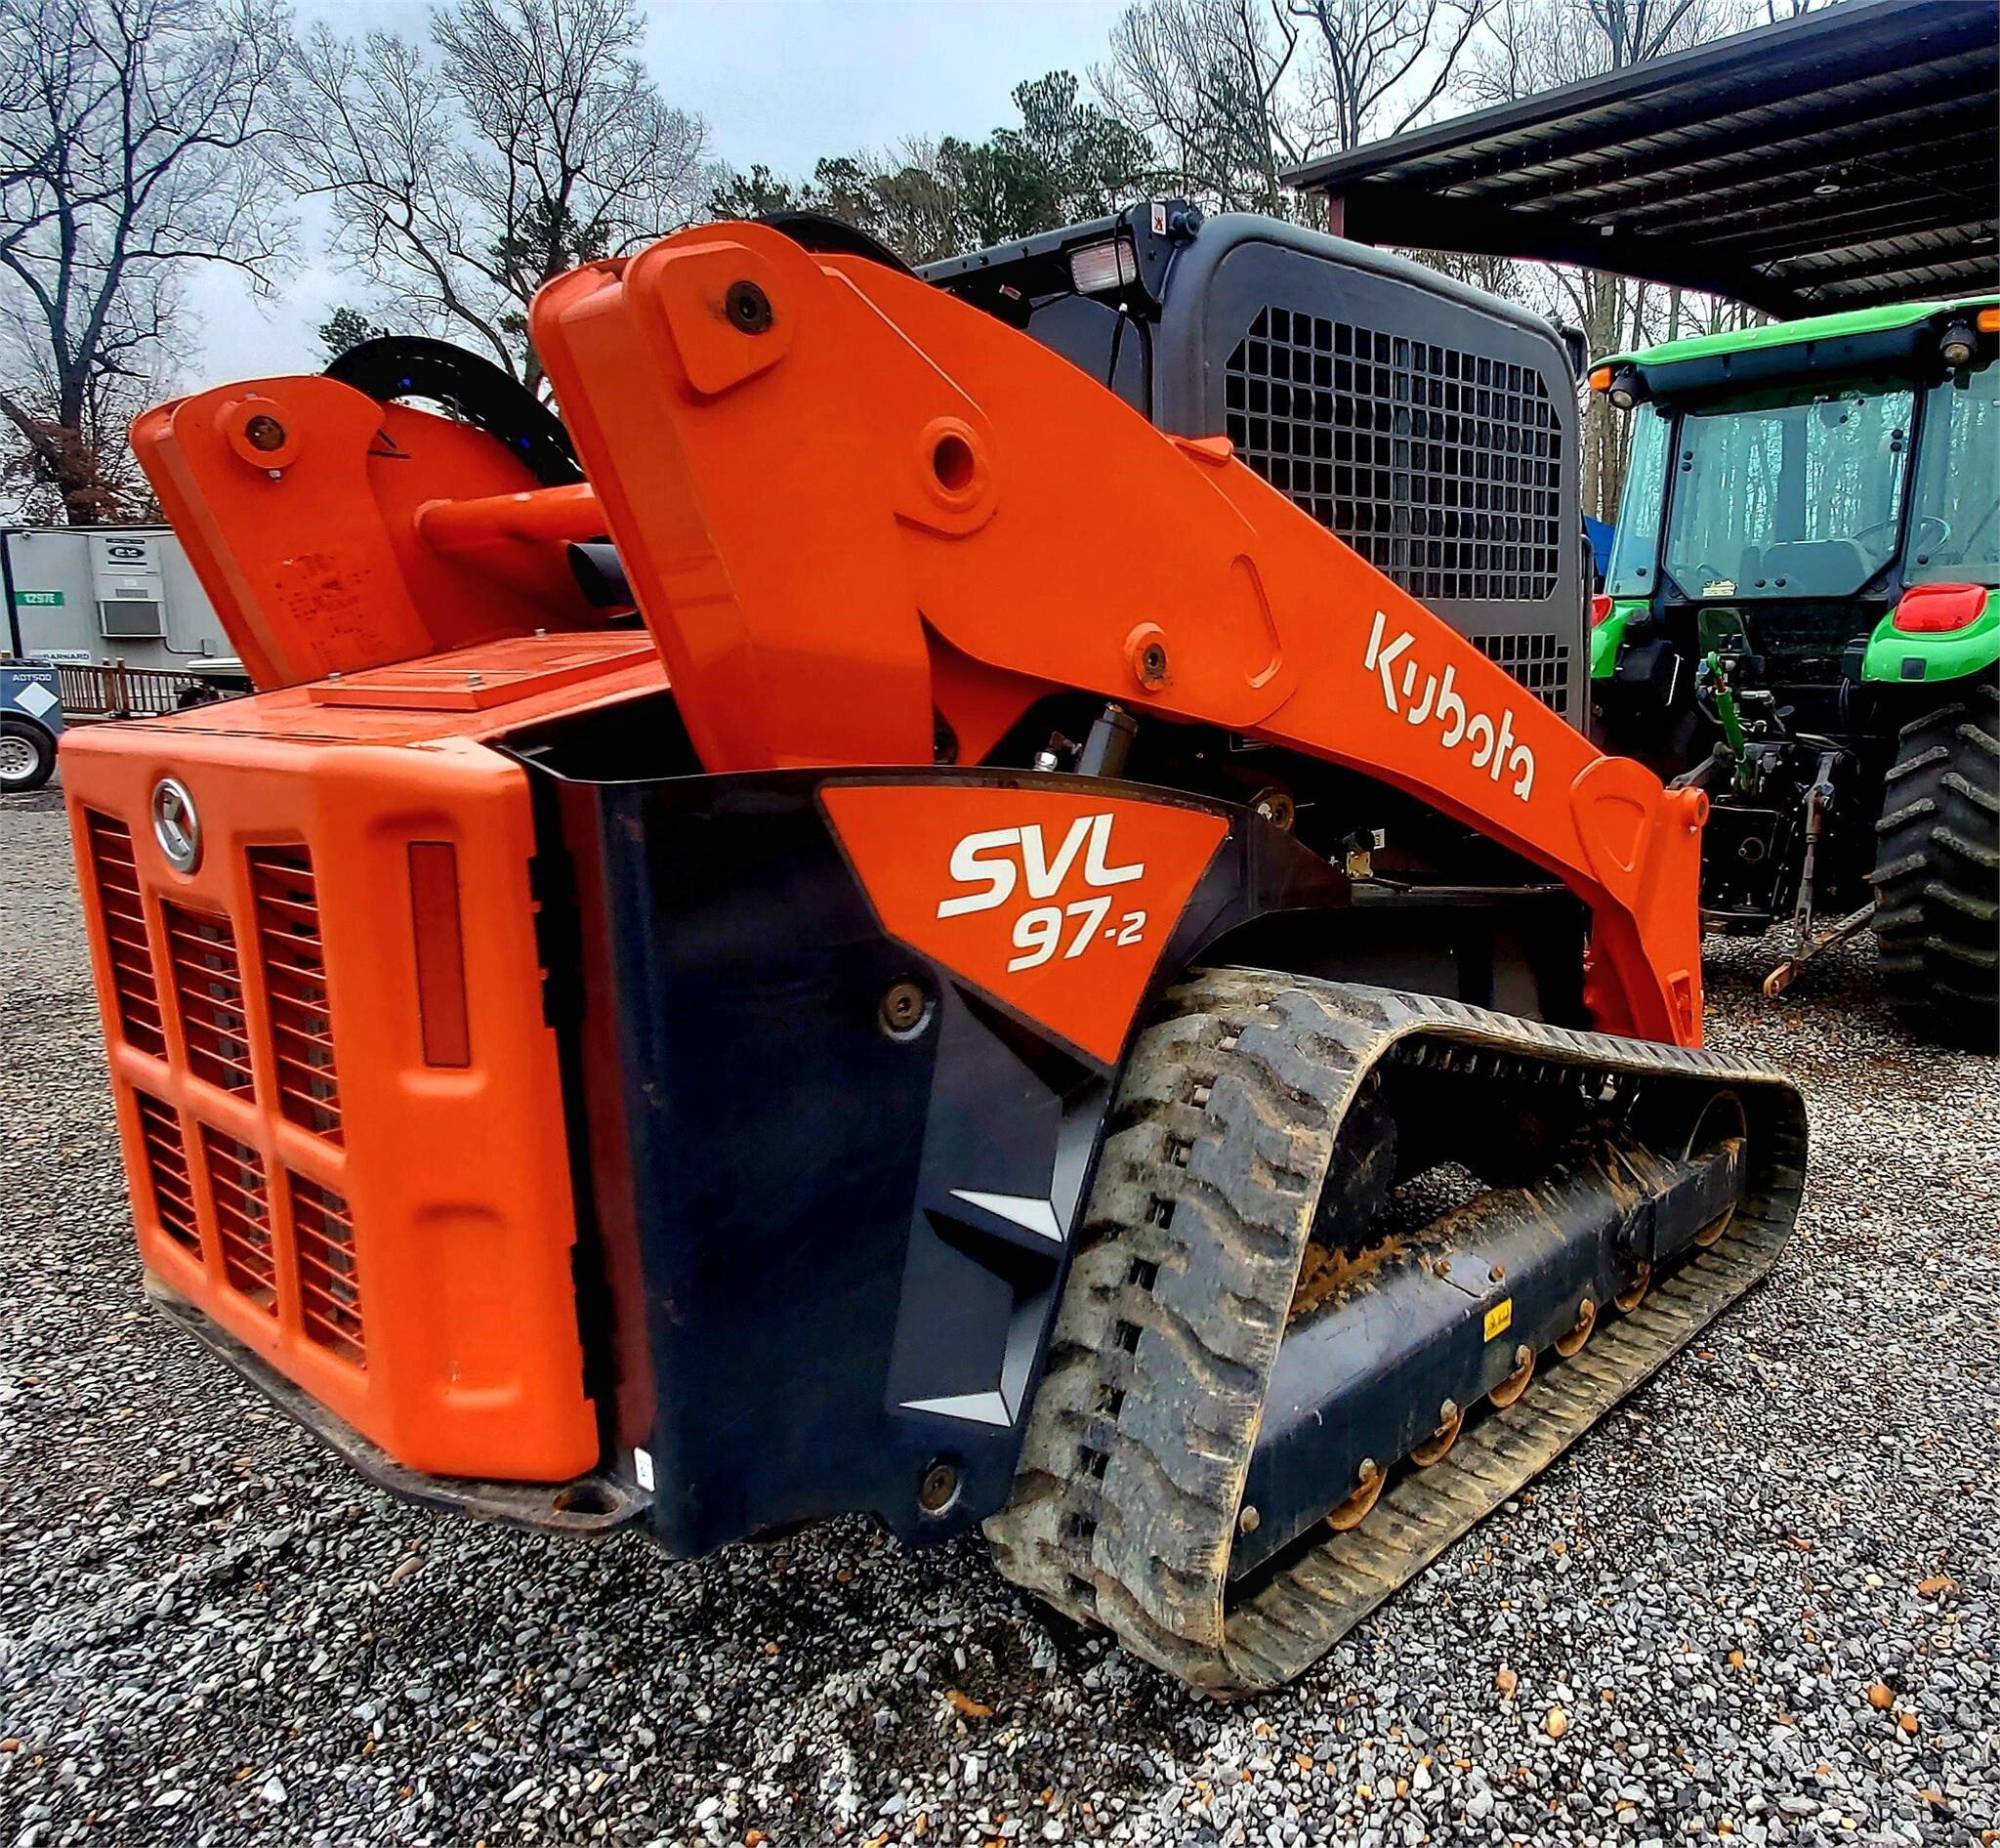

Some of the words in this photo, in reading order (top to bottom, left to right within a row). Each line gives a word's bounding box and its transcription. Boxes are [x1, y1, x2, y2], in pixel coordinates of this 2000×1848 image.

[1364, 609, 1535, 802] Kubota
[937, 813, 1145, 919] SVL
[1008, 896, 1146, 973] 97-2
